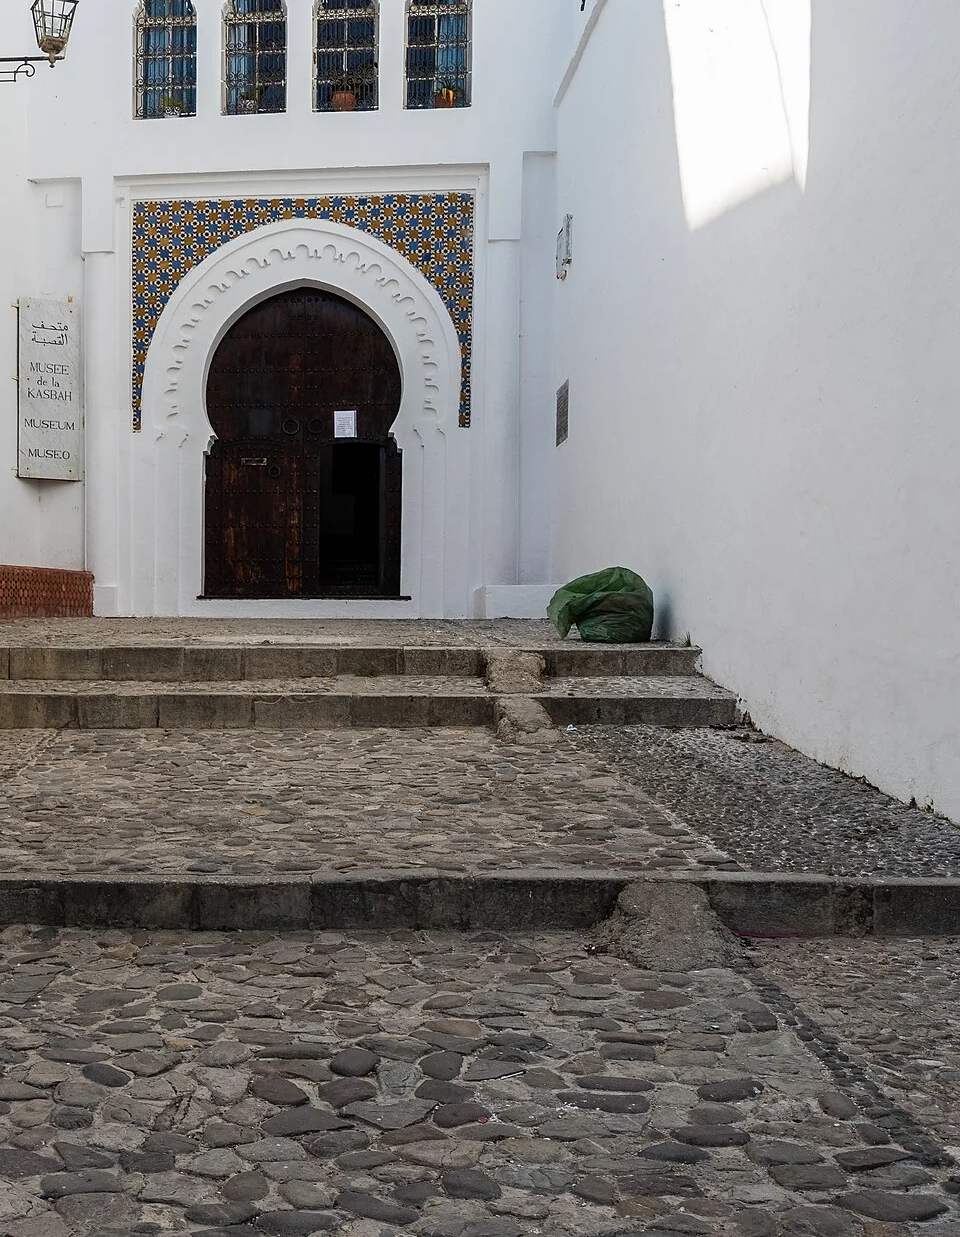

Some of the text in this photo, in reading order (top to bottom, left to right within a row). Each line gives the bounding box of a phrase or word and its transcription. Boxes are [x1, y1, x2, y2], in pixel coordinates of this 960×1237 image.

[32, 321, 68, 331] متحف
[30, 362, 69, 375] MUSEE
[37, 376, 60, 387] de la
[28, 387, 72, 401] KASBAH
[24, 418, 75, 431] MUSEUM
[28, 448, 70, 460] MUSEO
